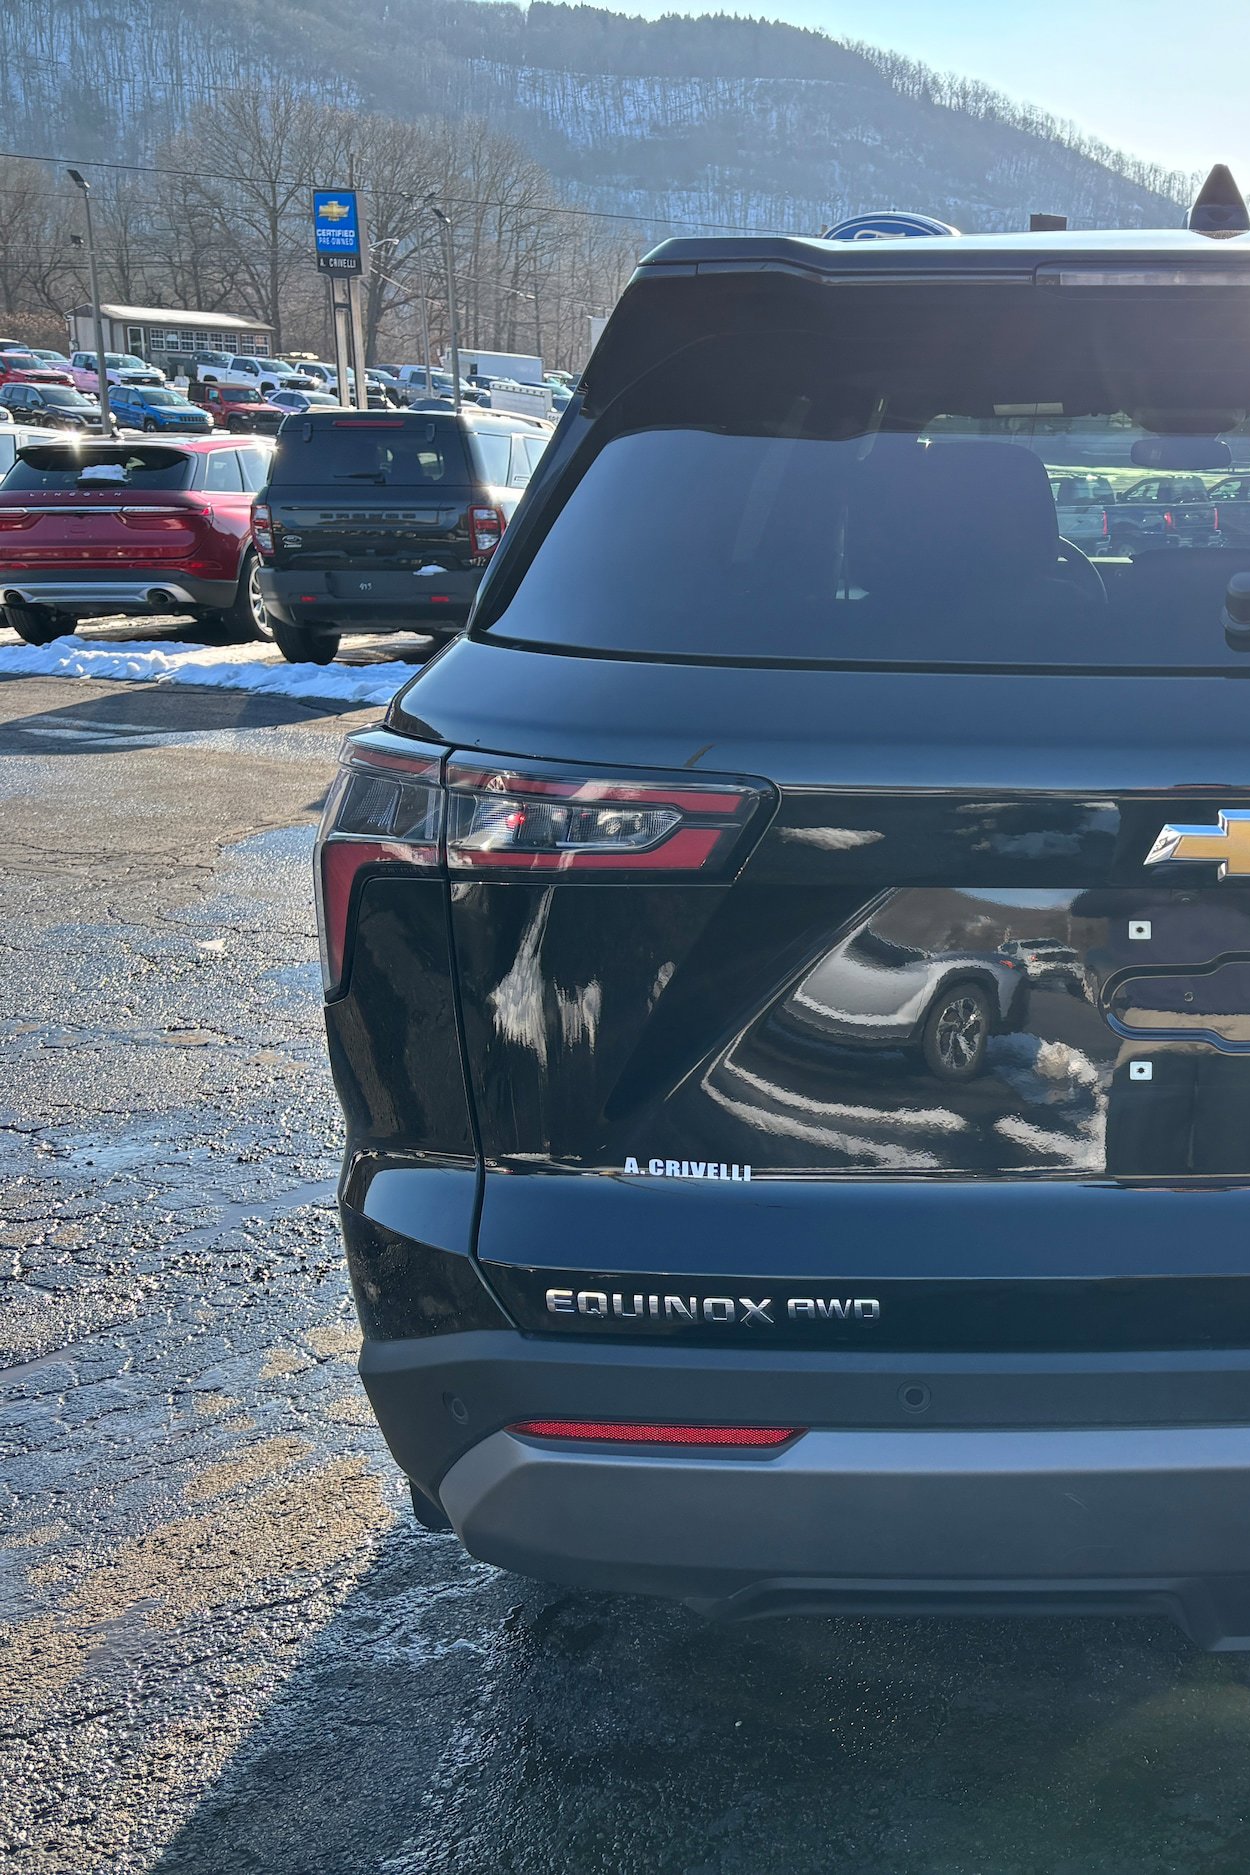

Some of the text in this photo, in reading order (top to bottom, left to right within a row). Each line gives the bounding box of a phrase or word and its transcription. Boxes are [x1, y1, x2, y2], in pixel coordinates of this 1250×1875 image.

[316, 229, 355, 238] CERTIFIED
[318, 237, 354, 245] PRE-OWNED
[329, 258, 356, 268] CRIVELLI
[545, 1288, 881, 1325] EQUINOX AWD
